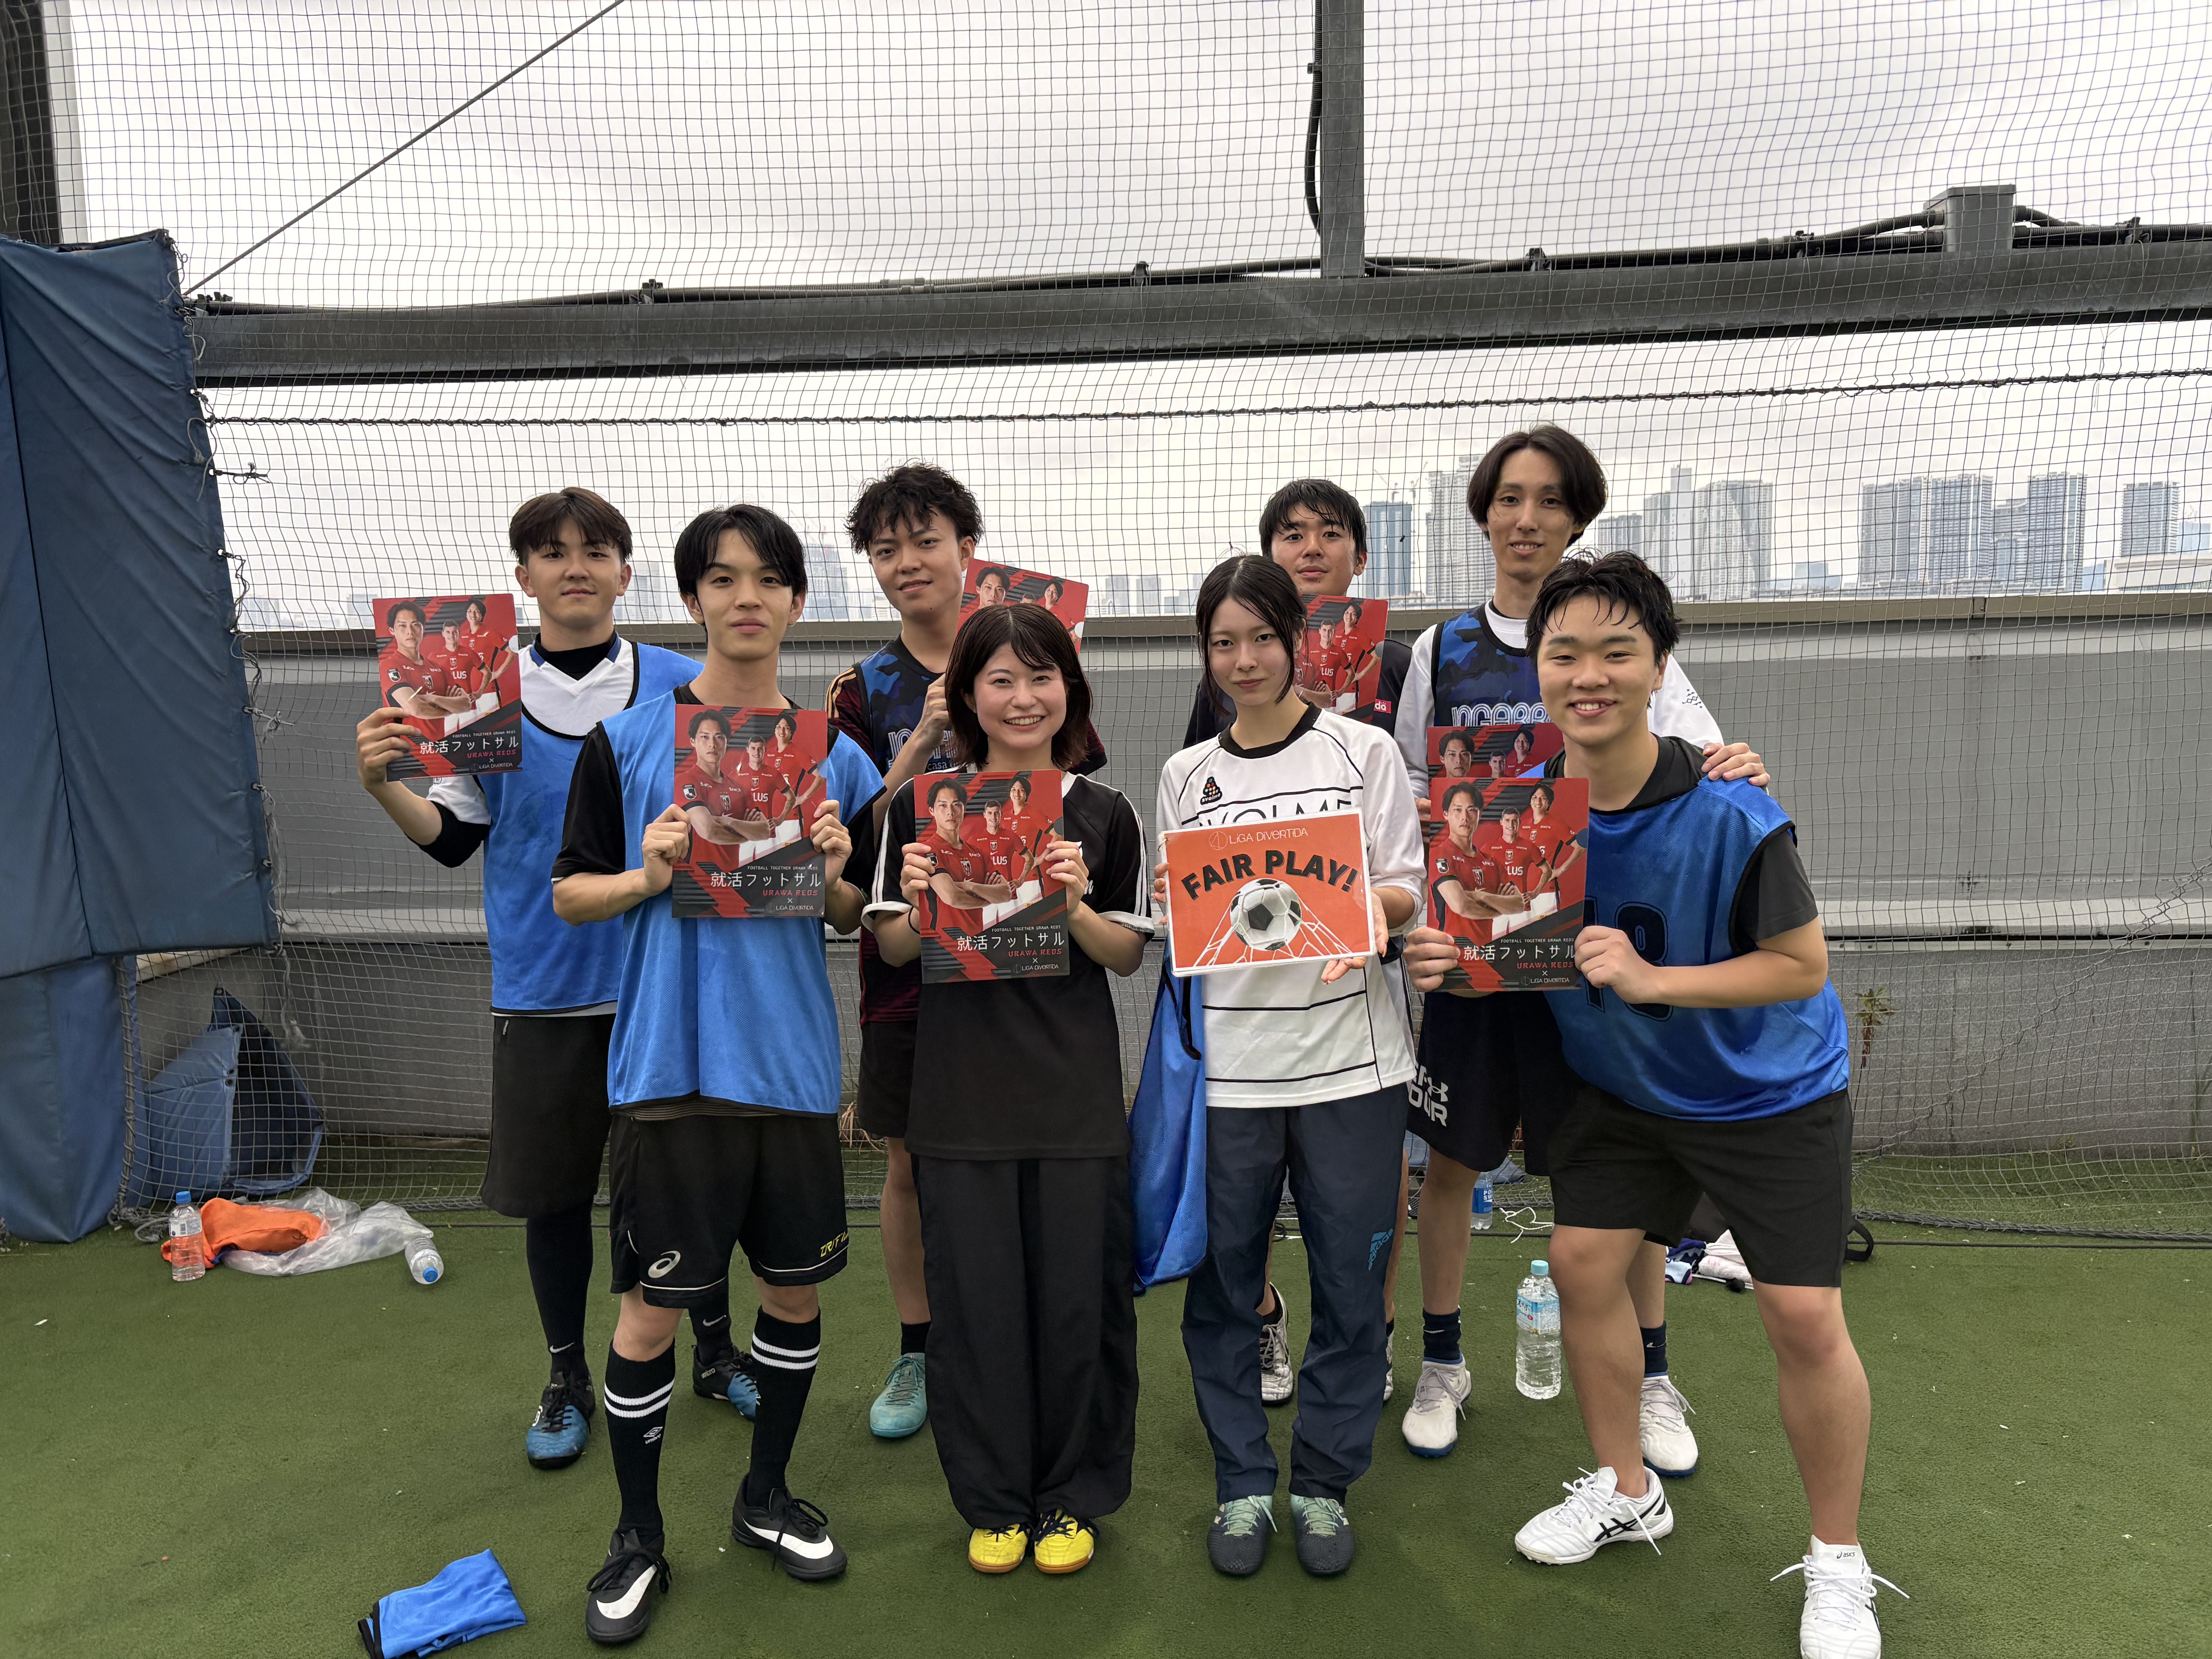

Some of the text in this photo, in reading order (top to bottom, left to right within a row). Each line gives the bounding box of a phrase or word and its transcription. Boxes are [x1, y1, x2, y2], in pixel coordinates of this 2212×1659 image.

[452, 670, 467, 679] LUS
[1320, 667, 1334, 676] LUS
[420, 736, 519, 754] 就活フットサル
[752, 793, 769, 802] LUS
[991, 856, 1007, 865] LUS
[1181, 850, 1358, 900] FAIR PLAY!
[1506, 866, 1523, 876] LUS
[710, 872, 821, 887] 就活フットサル
[957, 932, 1065, 951] 就活フットサル
[1463, 945, 1575, 960] 就活フットサル
[1368, 1228, 1393, 1271] adidas
[701, 1368, 716, 1379] umbro
